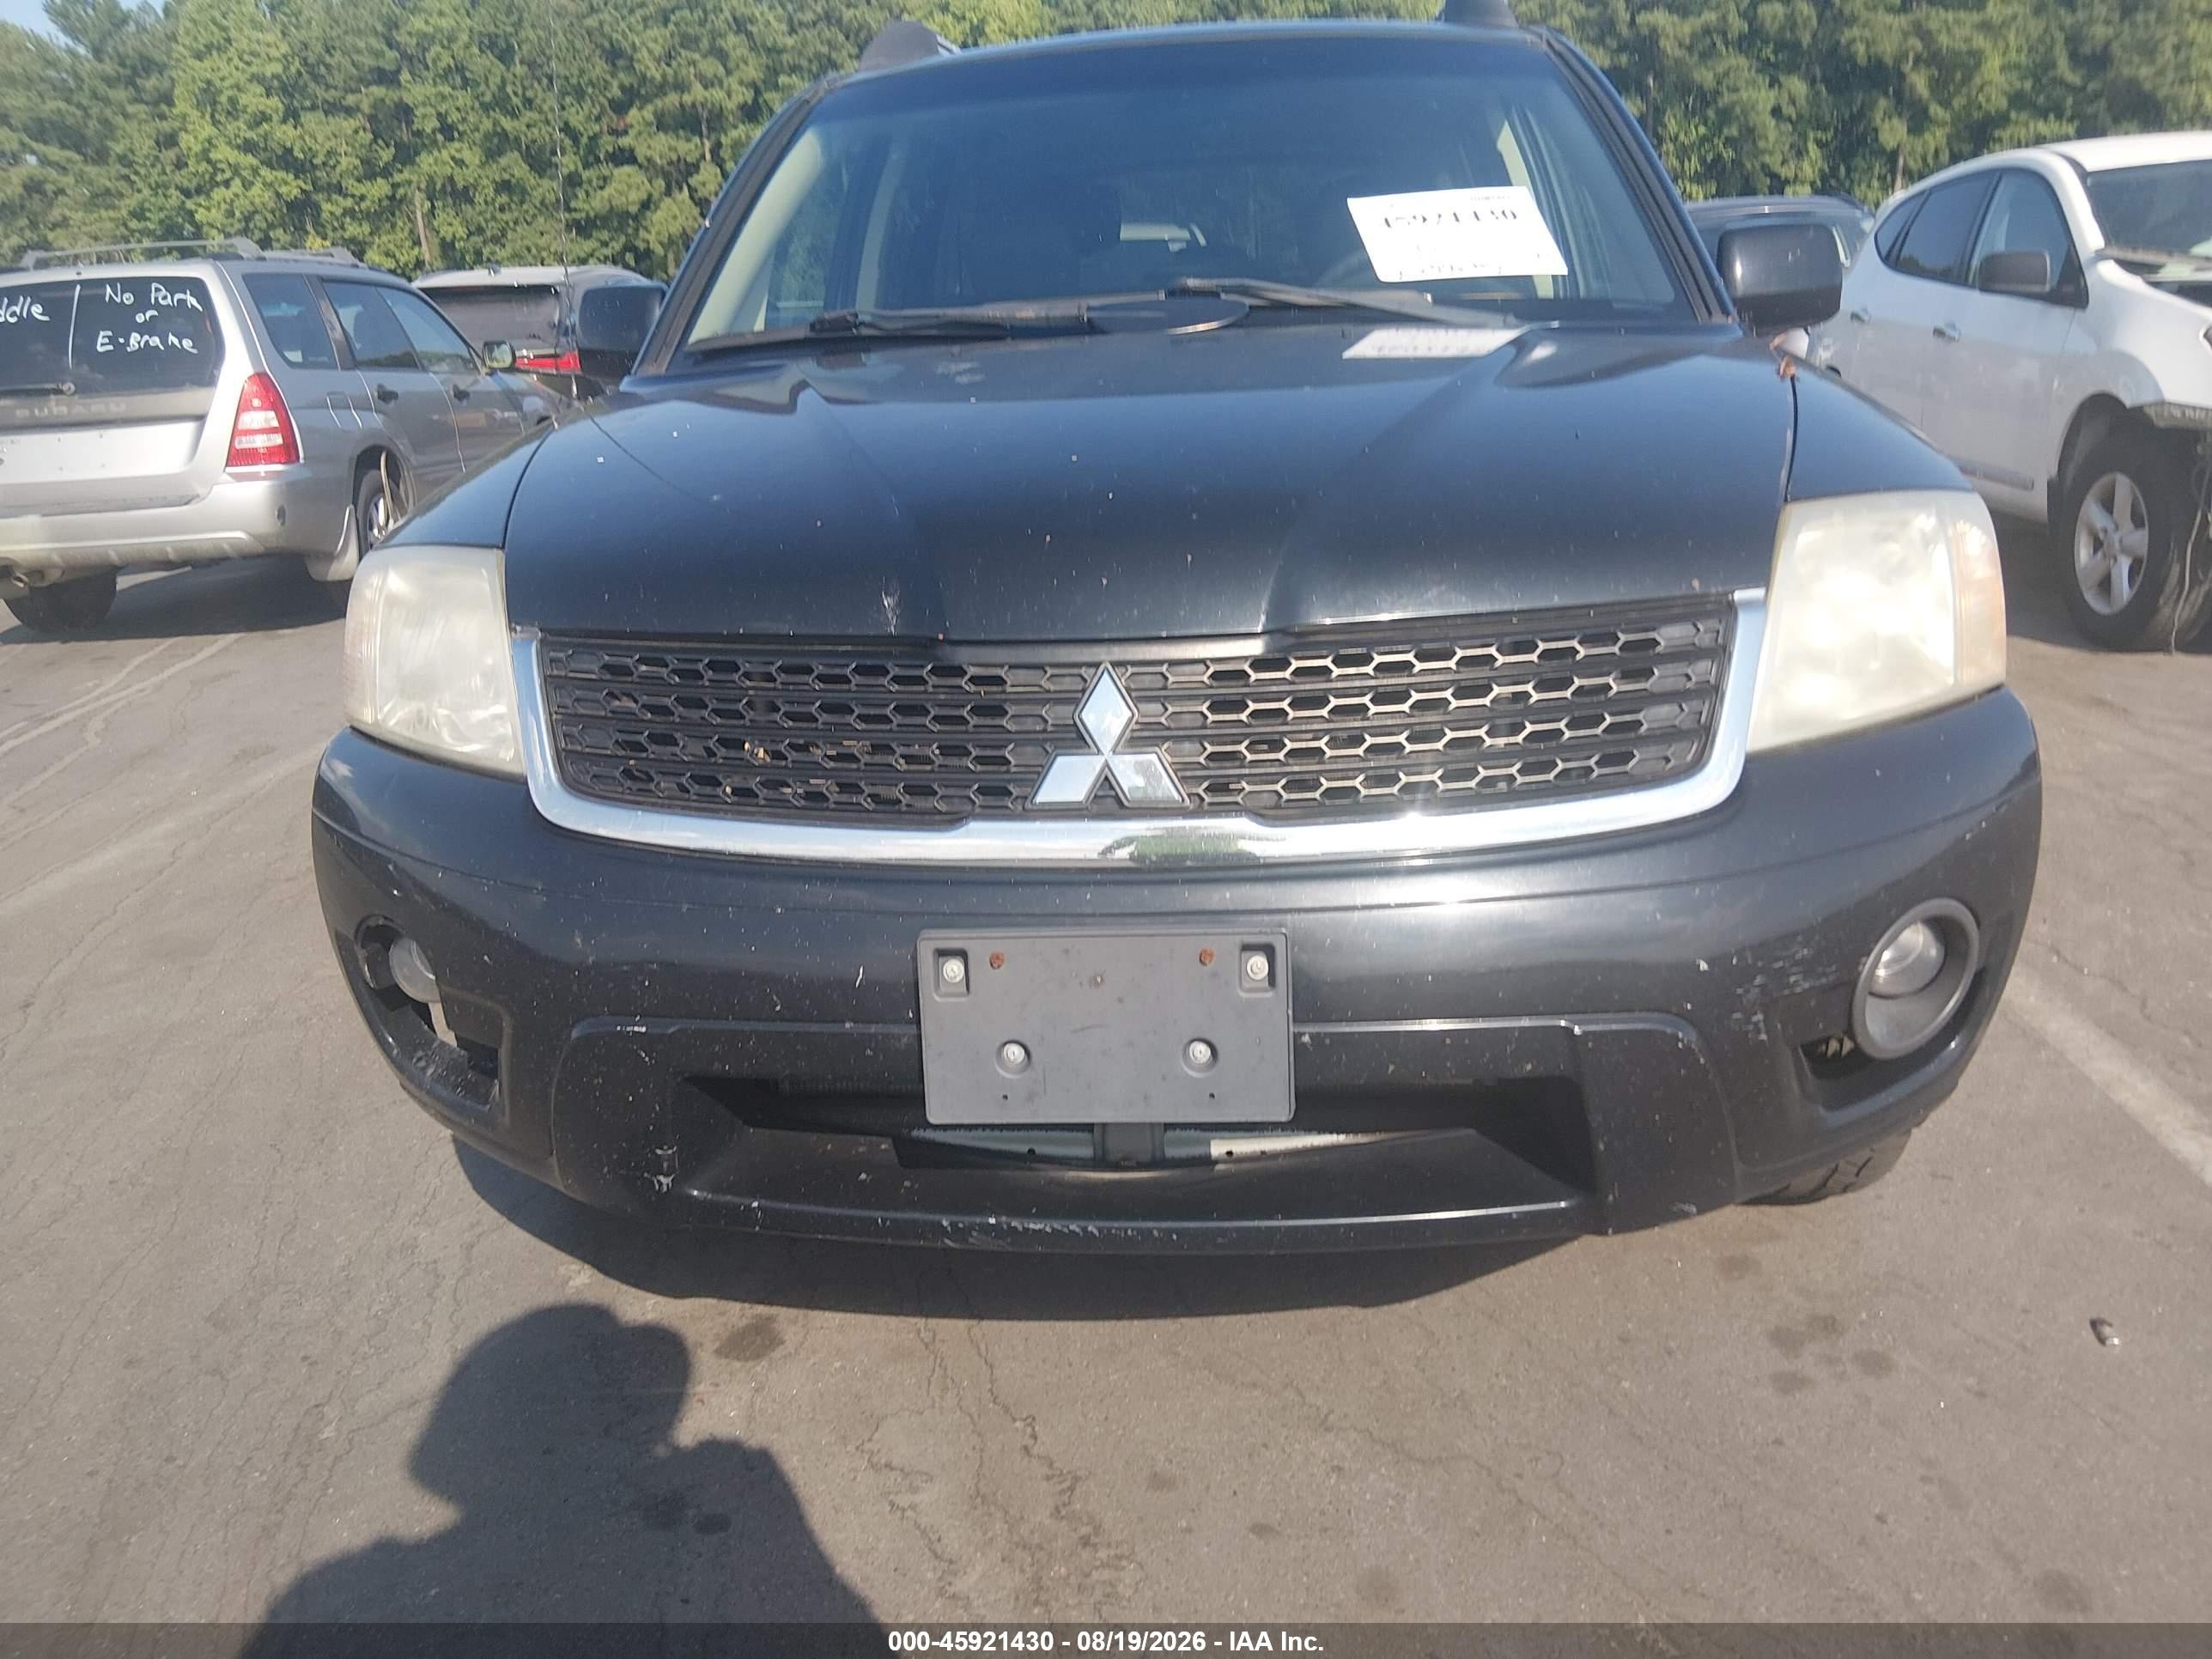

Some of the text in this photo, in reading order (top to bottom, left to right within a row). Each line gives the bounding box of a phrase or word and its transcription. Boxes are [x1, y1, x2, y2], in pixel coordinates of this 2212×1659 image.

[104, 282, 204, 313] No Park
[135, 309, 159, 324] or
